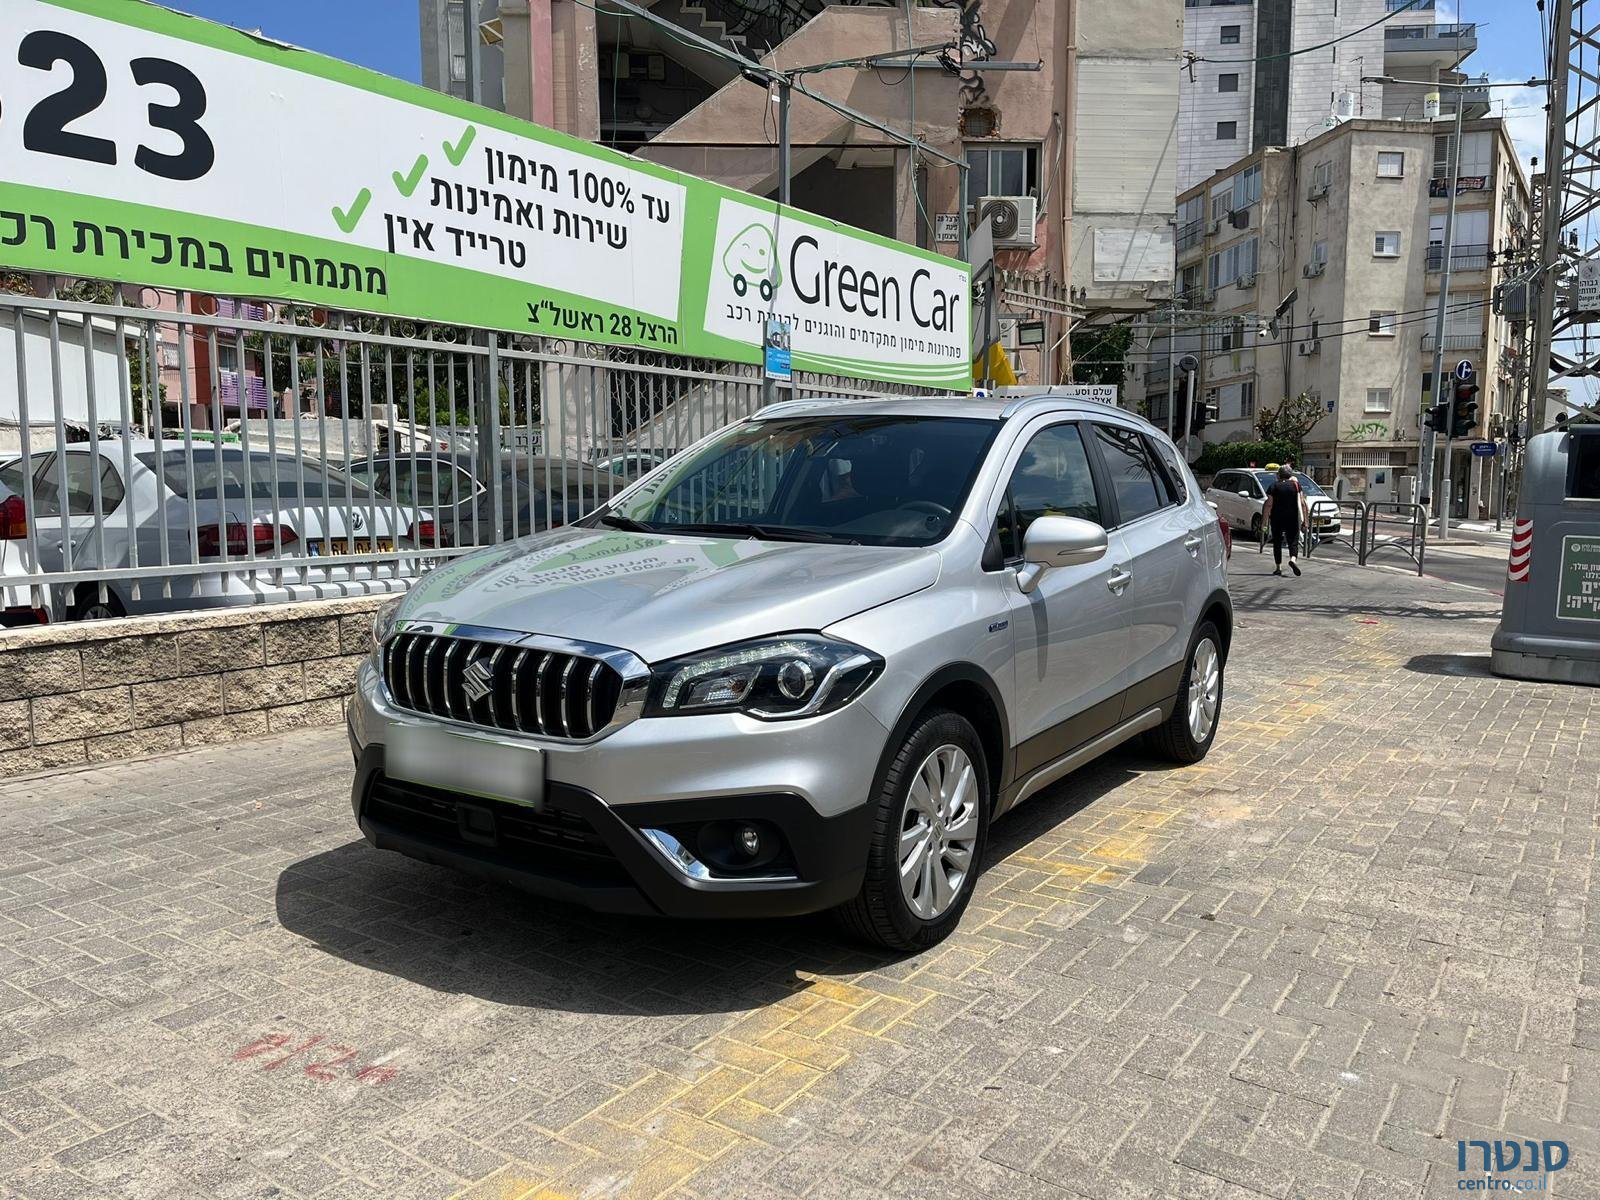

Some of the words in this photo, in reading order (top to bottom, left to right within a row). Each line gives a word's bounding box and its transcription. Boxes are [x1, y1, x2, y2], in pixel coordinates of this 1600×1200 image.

[485, 147, 558, 193] מימון
[430, 177, 544, 230] ואמינות
[568, 168, 635, 214] 100%
[641, 192, 670, 223] עד
[384, 213, 434, 253] אין
[553, 208, 628, 249] שירות
[72, 220, 233, 273] במכירת
[445, 225, 526, 268] טרייד
[245, 247, 387, 296] מתמחים
[789, 235, 900, 321] Green
[909, 268, 959, 333] Car
[609, 312, 632, 337] 28
[726, 303, 751, 322] רכב
[805, 319, 845, 339] והוגנים
[636, 318, 678, 345] הרצל
[850, 327, 897, 348] מתקדמים
[900, 336, 924, 353] מימון
[927, 341, 961, 359] פתרונות
[1092, 388, 1112, 396] שלם
